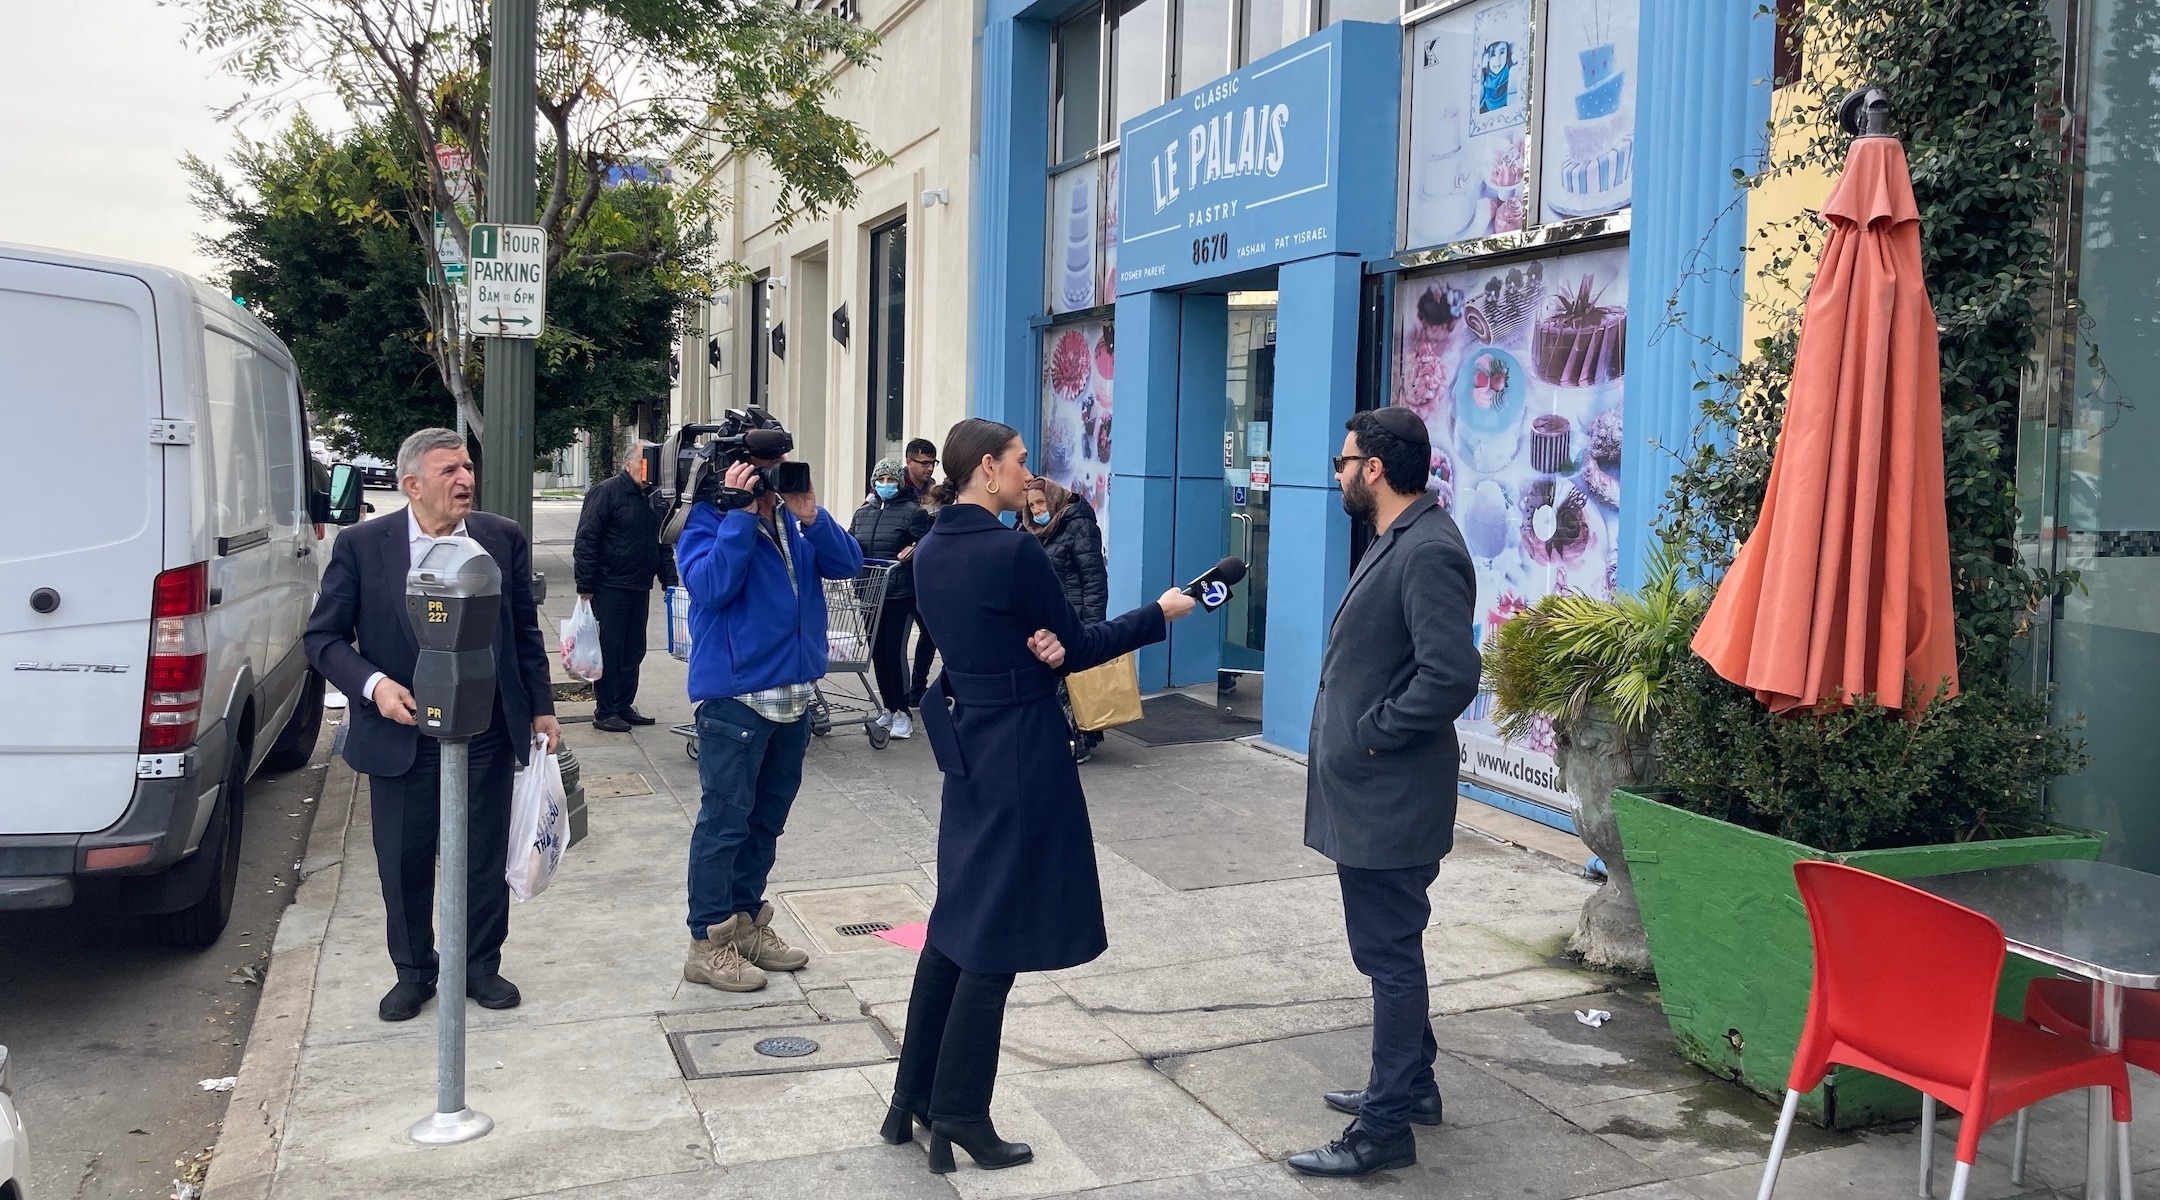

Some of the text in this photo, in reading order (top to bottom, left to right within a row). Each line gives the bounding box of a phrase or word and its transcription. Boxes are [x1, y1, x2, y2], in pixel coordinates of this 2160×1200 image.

[1194, 77, 1239, 110] CLASSIC
[1151, 103, 1289, 215] LE PALAIS
[1189, 200, 1239, 228] PASTRY
[481, 230, 540, 254] 1 HOUR
[1192, 232, 1228, 265] 8670
[1236, 227, 1328, 258] YASHAN PAT YISRAEL
[474, 261, 540, 283] PARKING
[1120, 264, 1166, 282] KOSHER PAREVE
[479, 285, 500, 302] 8AM
[514, 287, 535, 304] 6PM
[1200, 580, 1210, 593] abc
[428, 601, 444, 611] PR
[428, 612, 448, 623] 227
[14, 661, 130, 673] BLUETEC
[427, 706, 441, 718] PR
